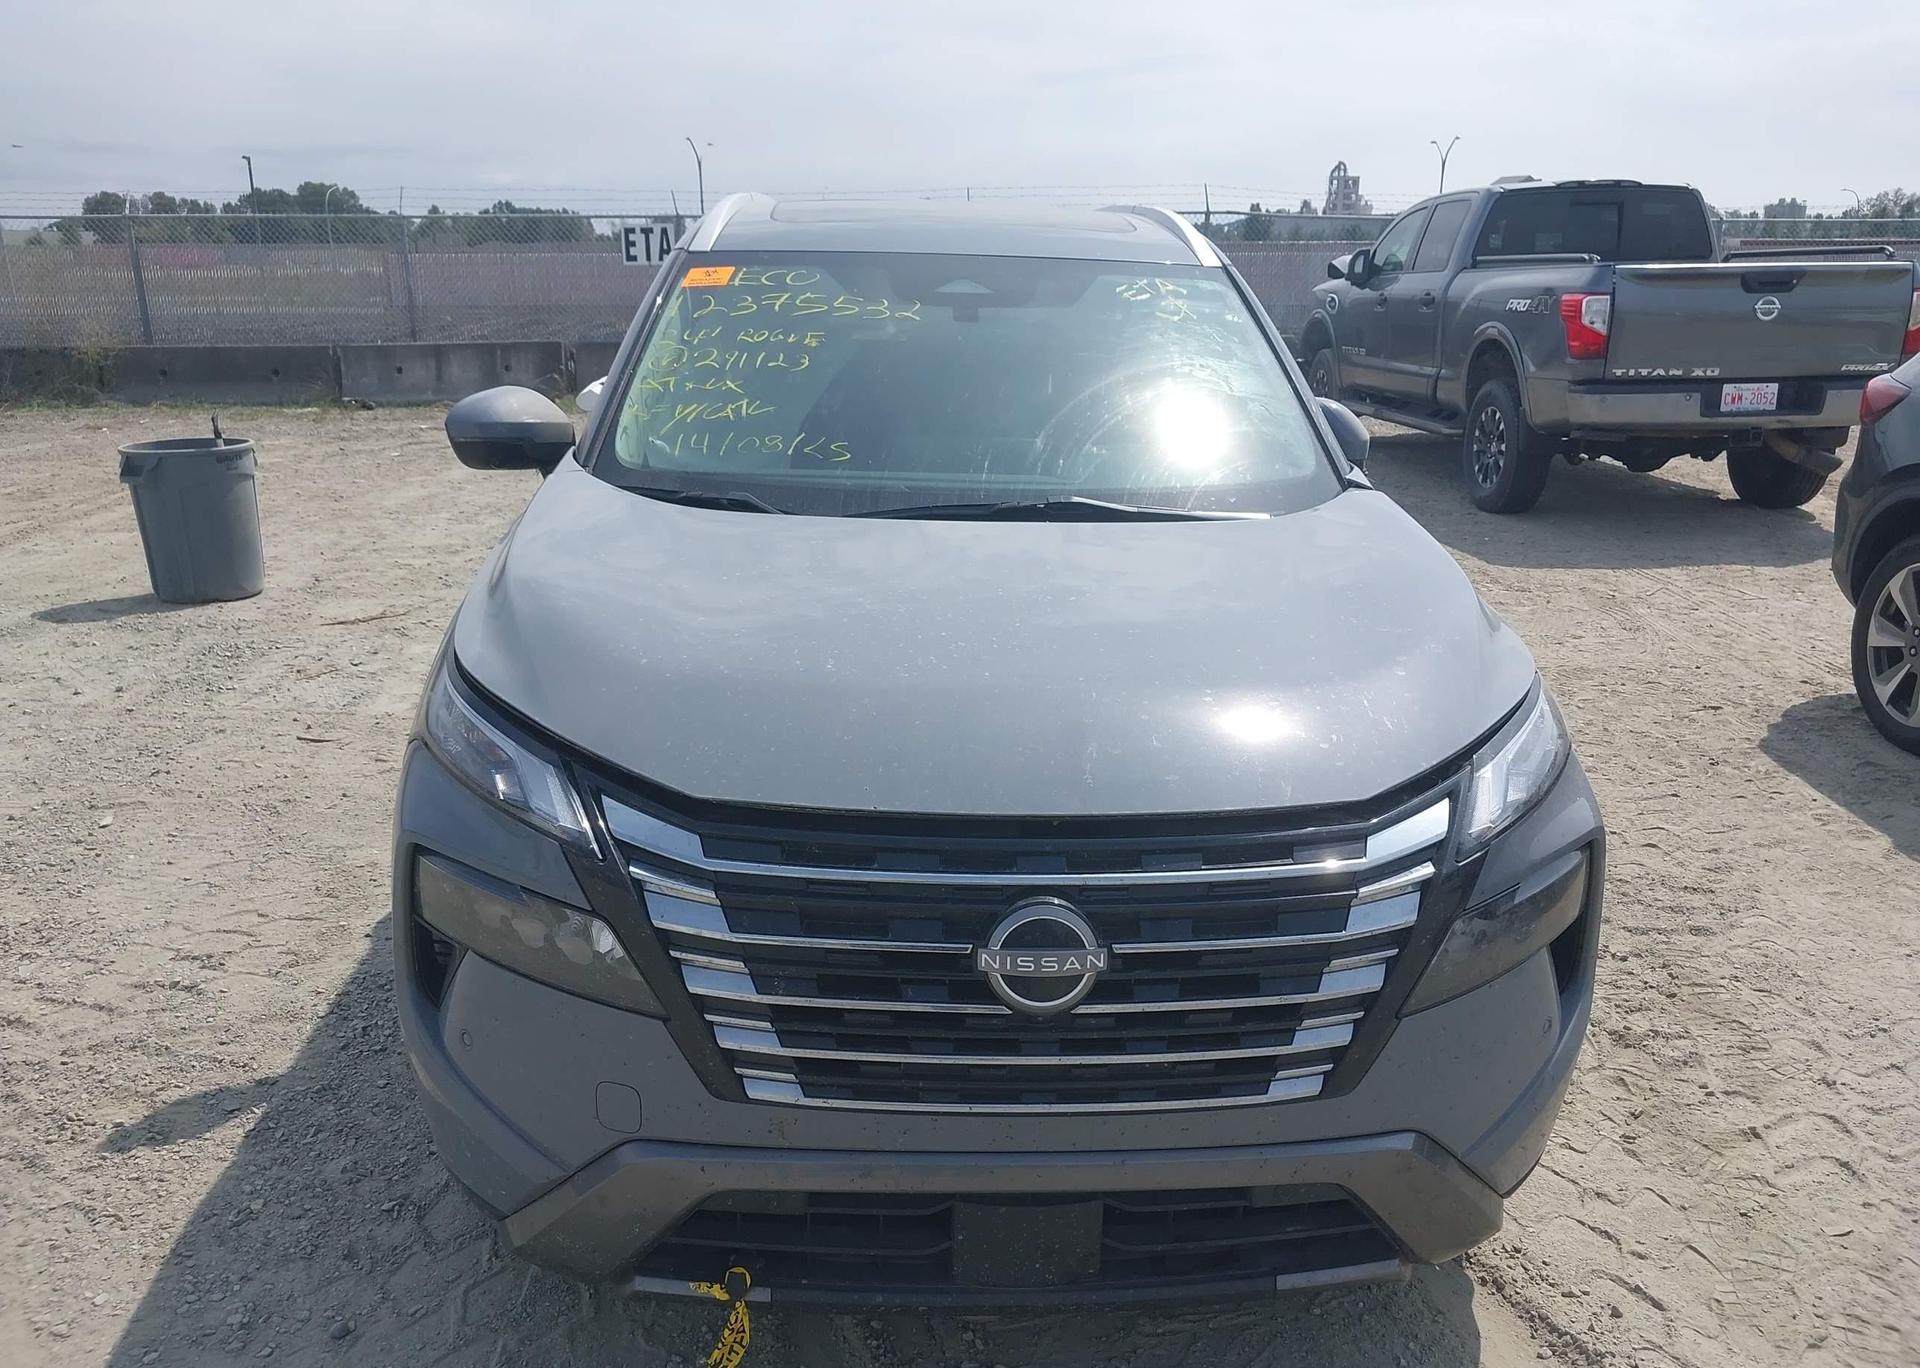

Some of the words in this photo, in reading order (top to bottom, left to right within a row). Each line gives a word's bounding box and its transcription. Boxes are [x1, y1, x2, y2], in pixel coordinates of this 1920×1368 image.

[623, 227, 673, 262] ETA
[1612, 368, 1683, 376] TITAN
[1690, 367, 1720, 376] XD
[981, 953, 1104, 972] NISSAN
